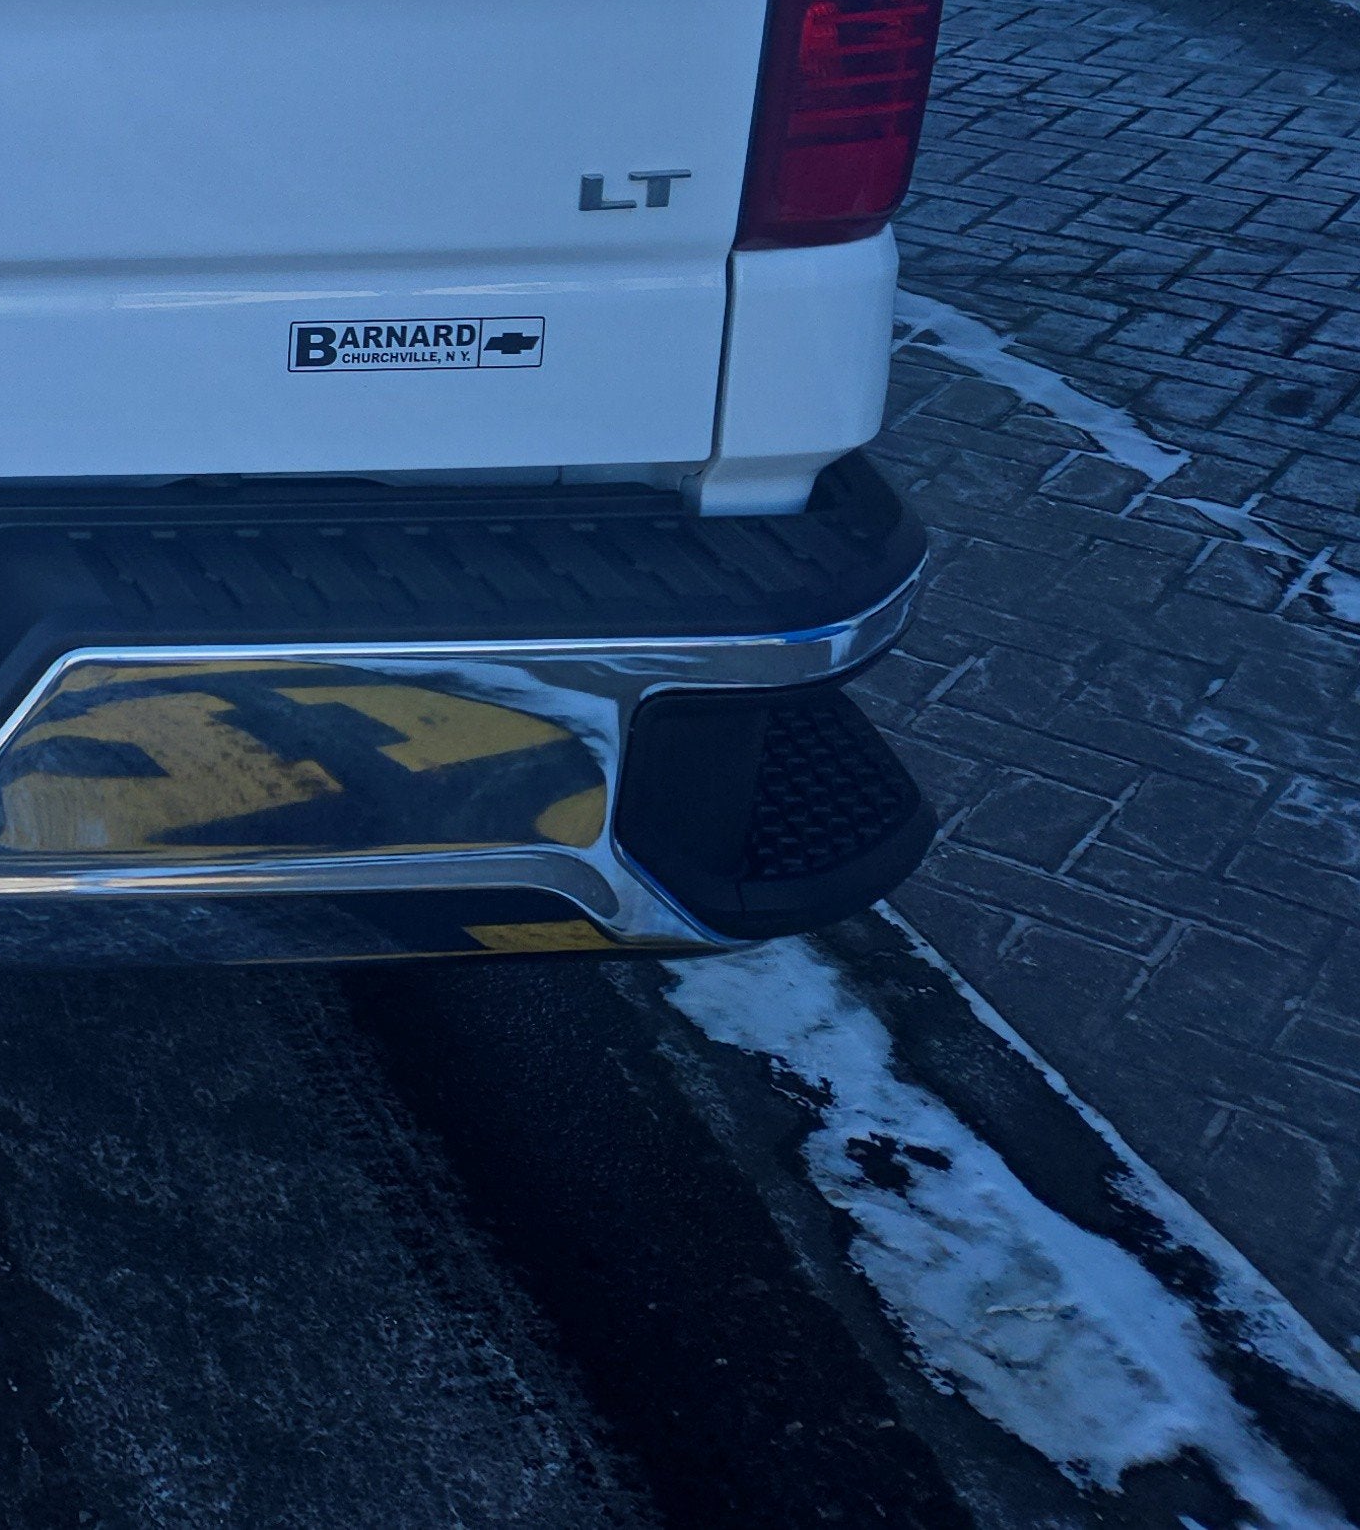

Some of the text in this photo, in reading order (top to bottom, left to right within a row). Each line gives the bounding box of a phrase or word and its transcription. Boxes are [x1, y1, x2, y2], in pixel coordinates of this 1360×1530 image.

[578, 169, 692, 211] LT
[295, 324, 477, 367] BARNARD
[341, 351, 443, 365] CHURCHVILLE,
